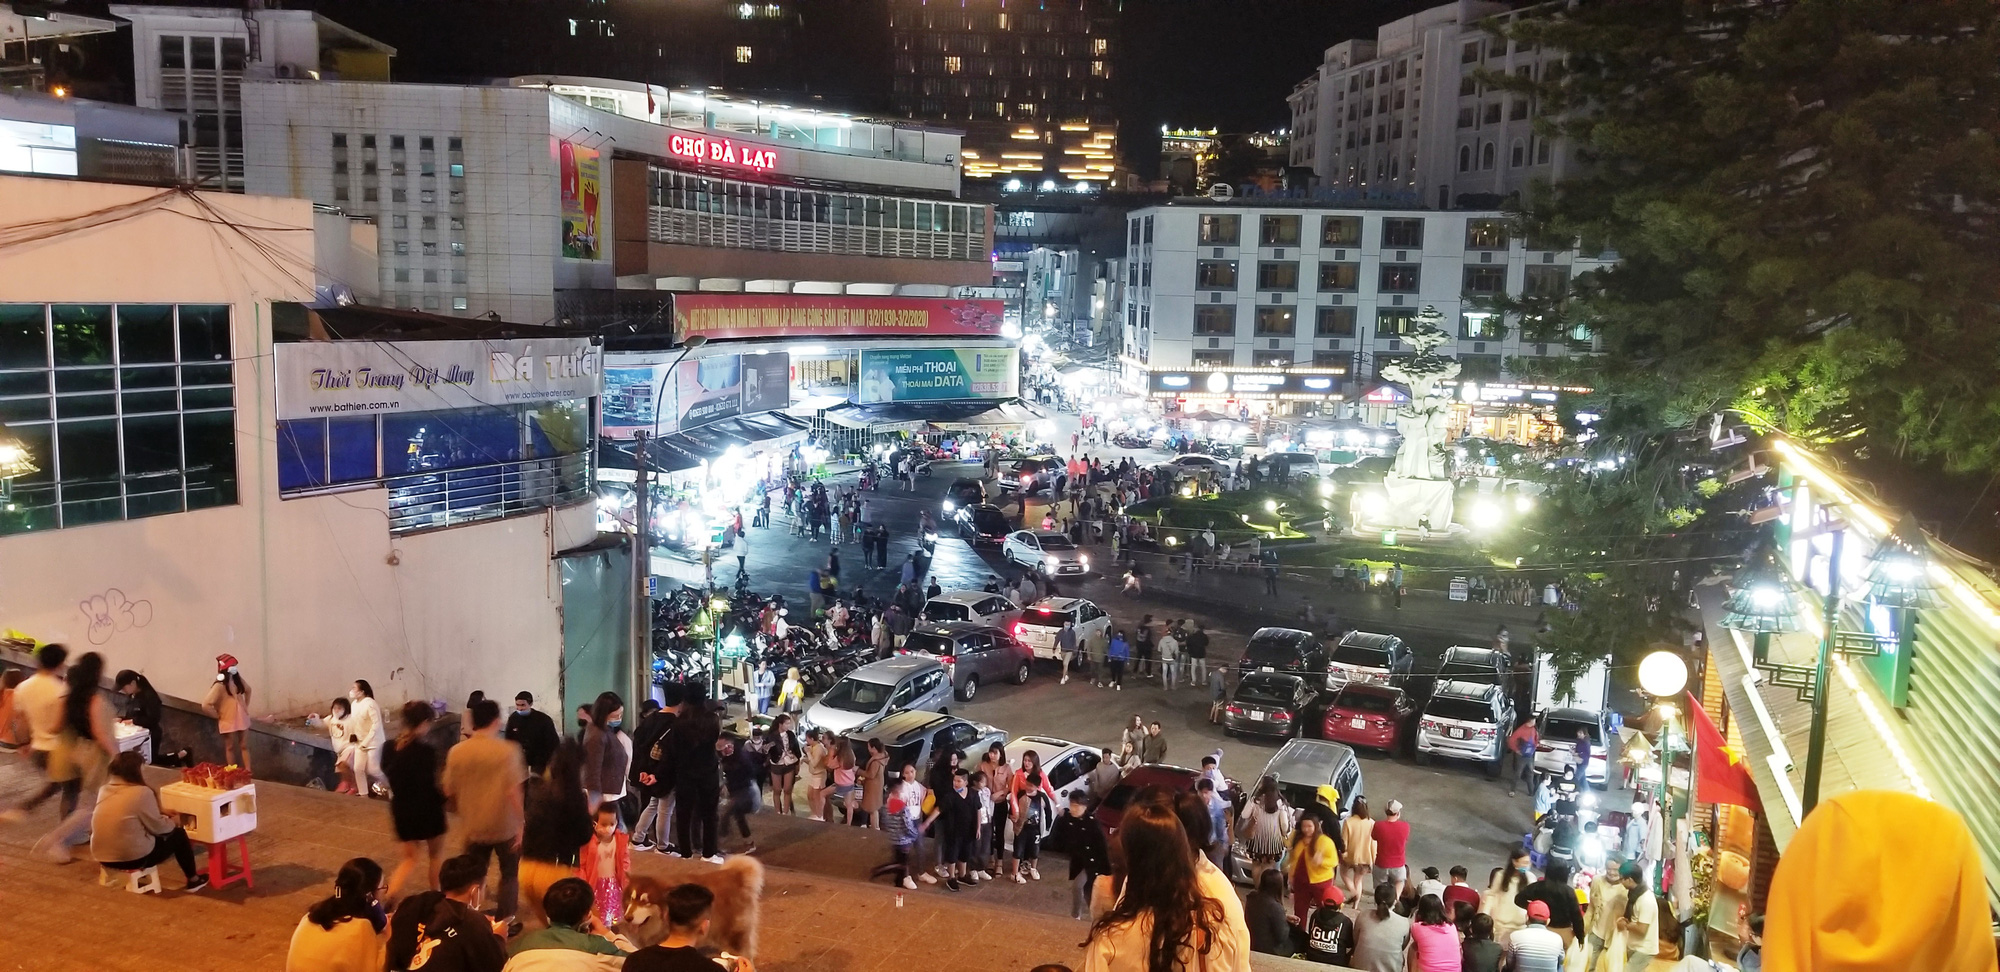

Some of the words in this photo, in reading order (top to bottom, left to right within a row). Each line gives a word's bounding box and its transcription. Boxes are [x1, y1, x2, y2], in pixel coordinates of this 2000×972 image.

[671, 135, 705, 163] CHỢ
[710, 139, 736, 163] ĐÀ
[741, 148, 777, 172] LẠT
[850, 308, 865, 327] NAM
[490, 345, 533, 383] BÁ
[924, 361, 957, 374] THOẠI
[310, 368, 351, 391] Thời
[355, 367, 405, 392] Trang
[408, 363, 440, 390] Dệt
[443, 364, 475, 386] May
[934, 375, 964, 387] DATA
[309, 401, 400, 414] www.bathien.com.vn
